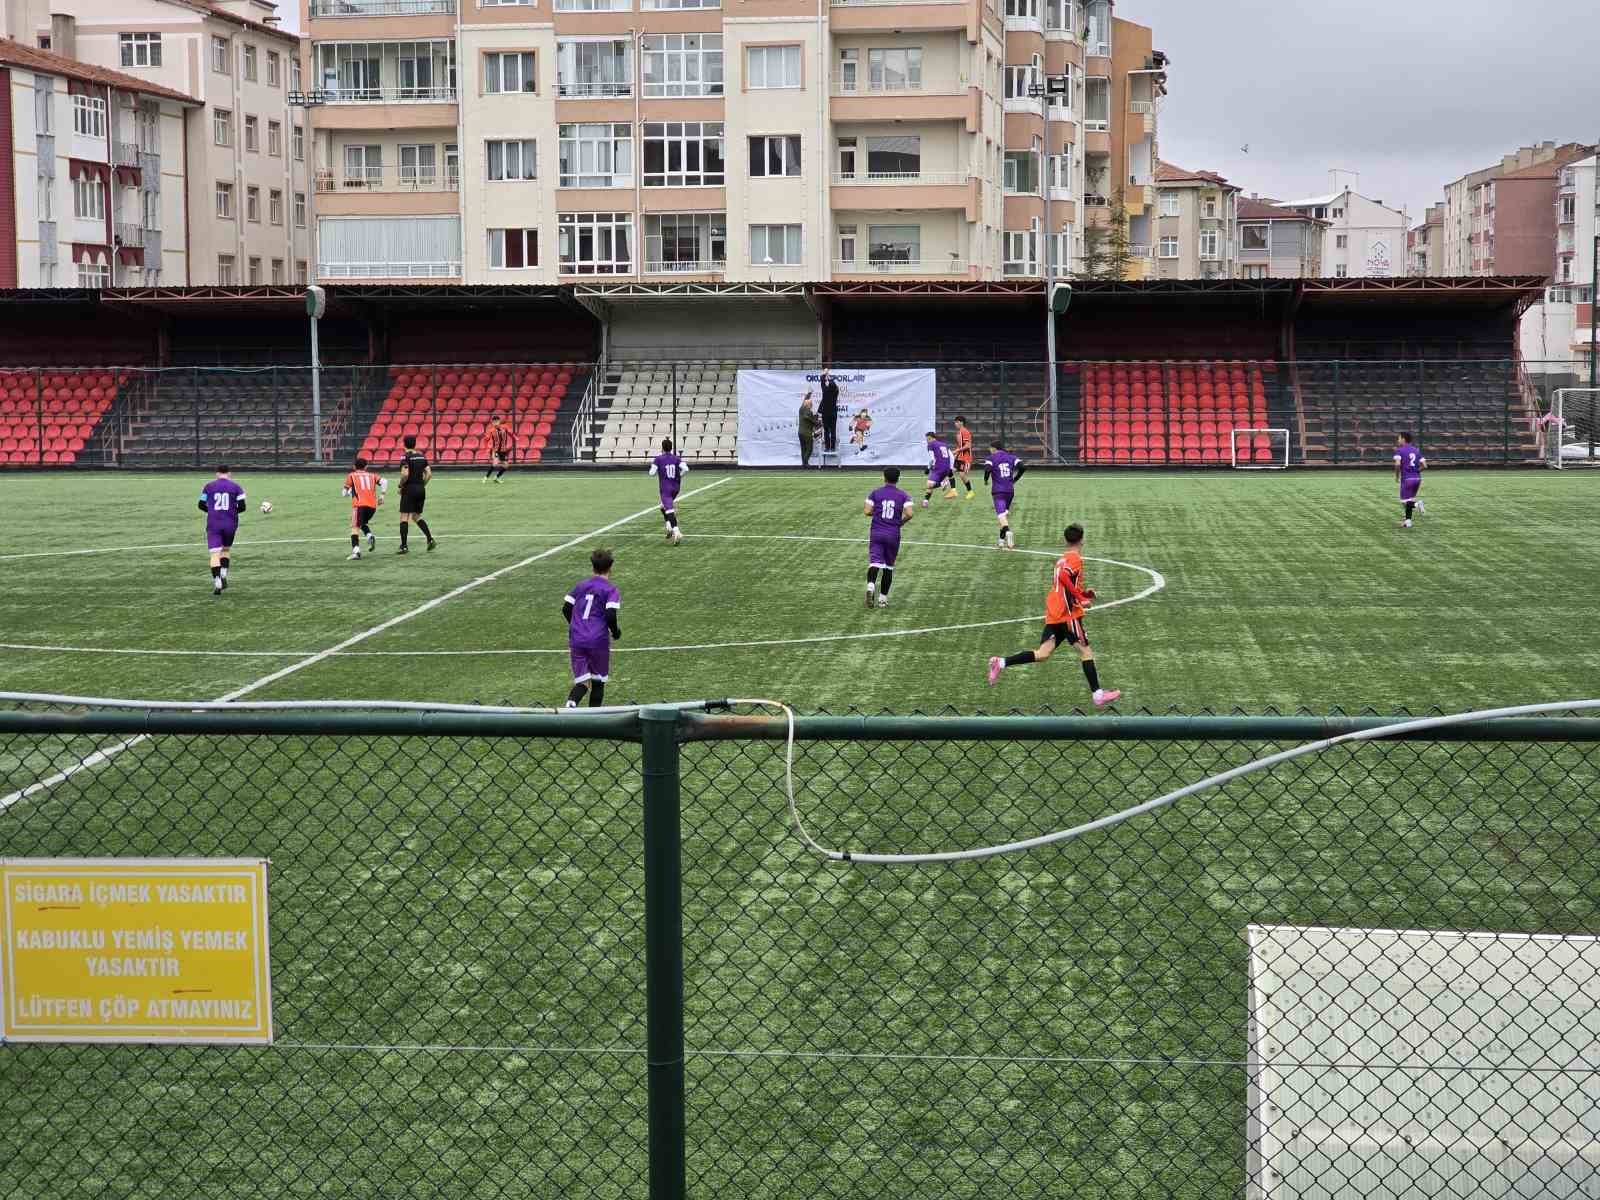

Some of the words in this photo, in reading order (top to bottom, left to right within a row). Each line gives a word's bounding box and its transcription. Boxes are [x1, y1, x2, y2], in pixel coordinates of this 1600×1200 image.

[998, 462, 1010, 478] 15
[1408, 453, 1416, 467] 2
[665, 463, 676, 479] 10
[359, 475, 371, 490] 11
[213, 492, 230, 511] 20
[881, 499, 896, 520] 16
[581, 594, 594, 620] 7
[15, 880, 83, 904] SİGARA
[88, 879, 150, 909] İÇMEK
[155, 884, 248, 904] YASAKTIR
[16, 929, 105, 950] KABUKLU
[112, 924, 175, 954] YEMİŞ
[180, 930, 249, 951] YEMEK
[86, 956, 180, 977] YASAKTIR
[18, 994, 93, 1018] LÜTFEN
[99, 993, 140, 1023] ÇÖP
[145, 998, 254, 1019] ATMAYINIZ
